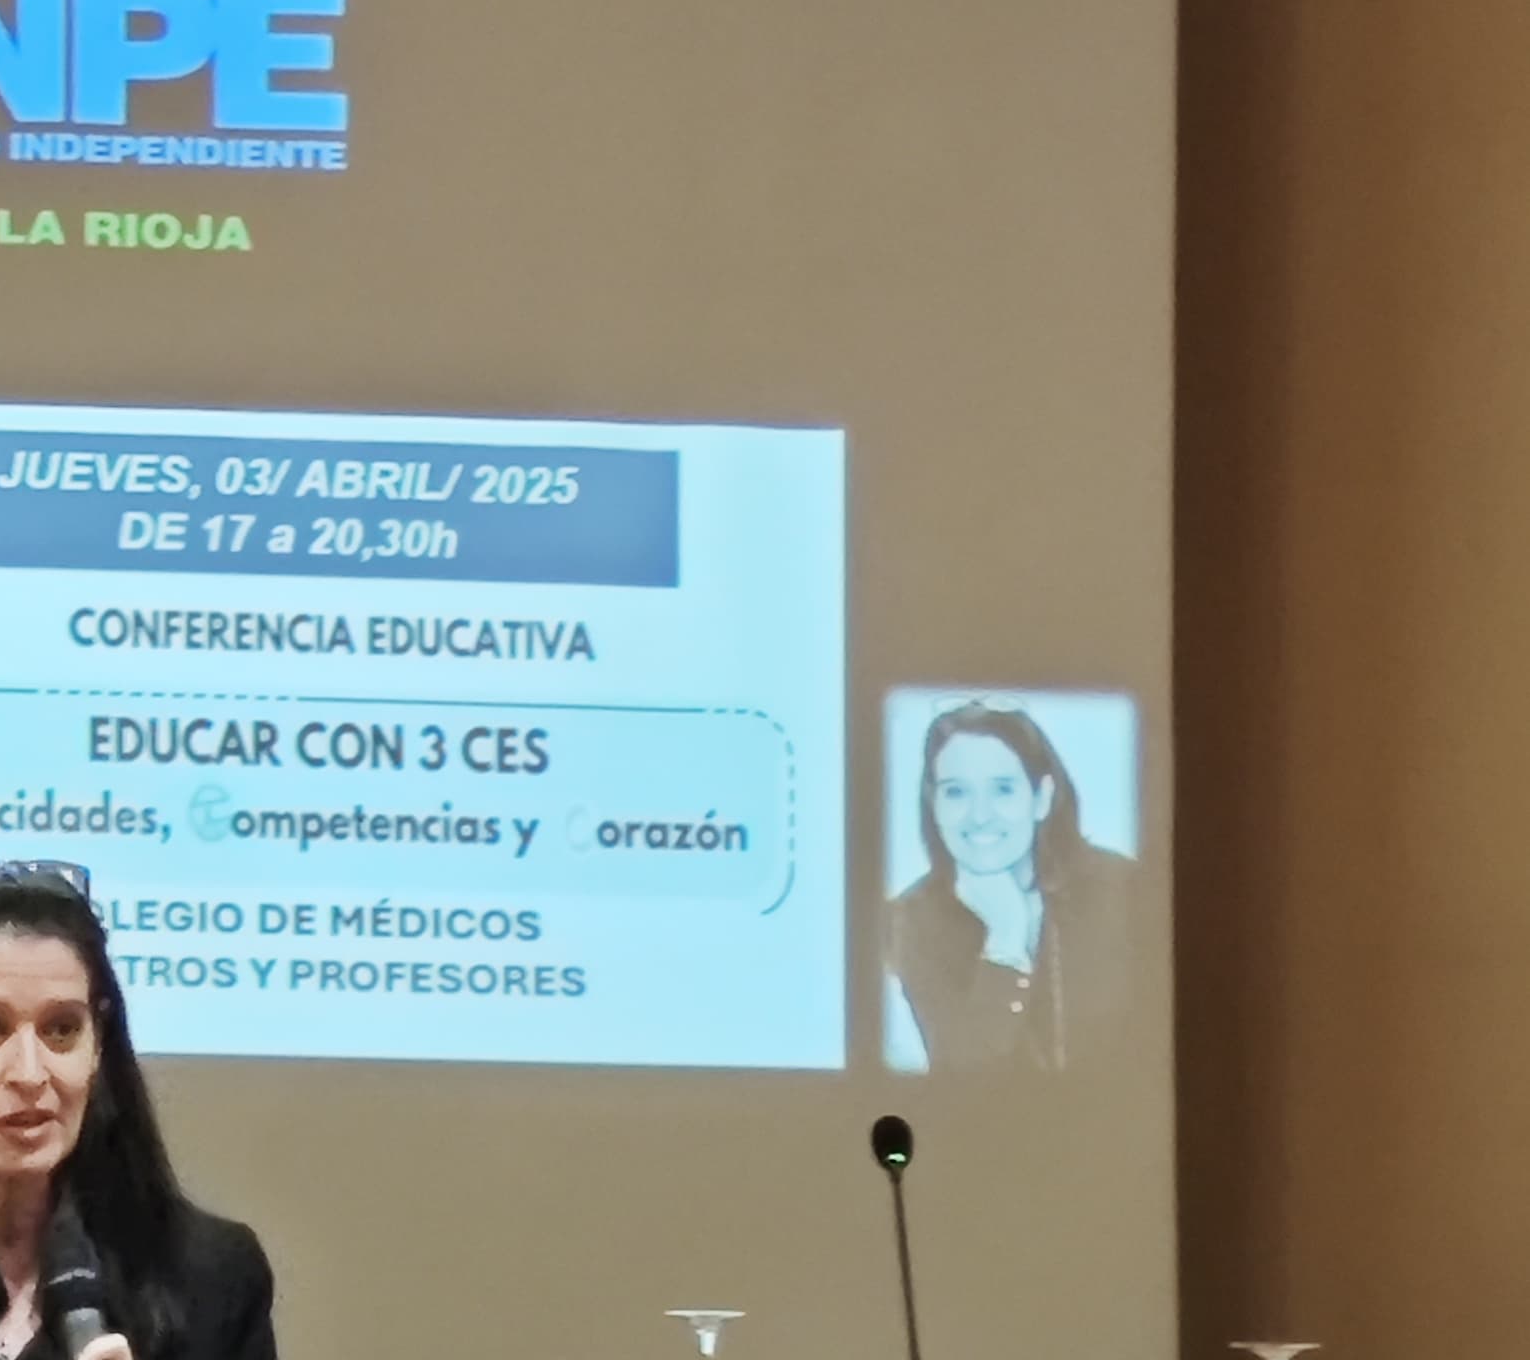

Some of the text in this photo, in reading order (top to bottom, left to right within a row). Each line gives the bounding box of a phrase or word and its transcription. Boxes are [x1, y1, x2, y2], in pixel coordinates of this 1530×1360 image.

[9, 131, 347, 170] INDEPENDIENTE
[84, 211, 252, 252] RIOJA
[216, 456, 292, 497] 03/
[296, 458, 462, 502] ABRIL/
[471, 464, 580, 505] 2025
[117, 511, 459, 562] DE 17 a 20,30h
[69, 607, 596, 662] CONFERENCIA EDUCATIVA
[88, 715, 550, 775] EDUCAR CON 3 CES
[513, 816, 540, 858] y
[91, 898, 543, 942] LEGIO DE MÉDICOS
[117, 955, 587, 998] TROS Y PROFESORES
